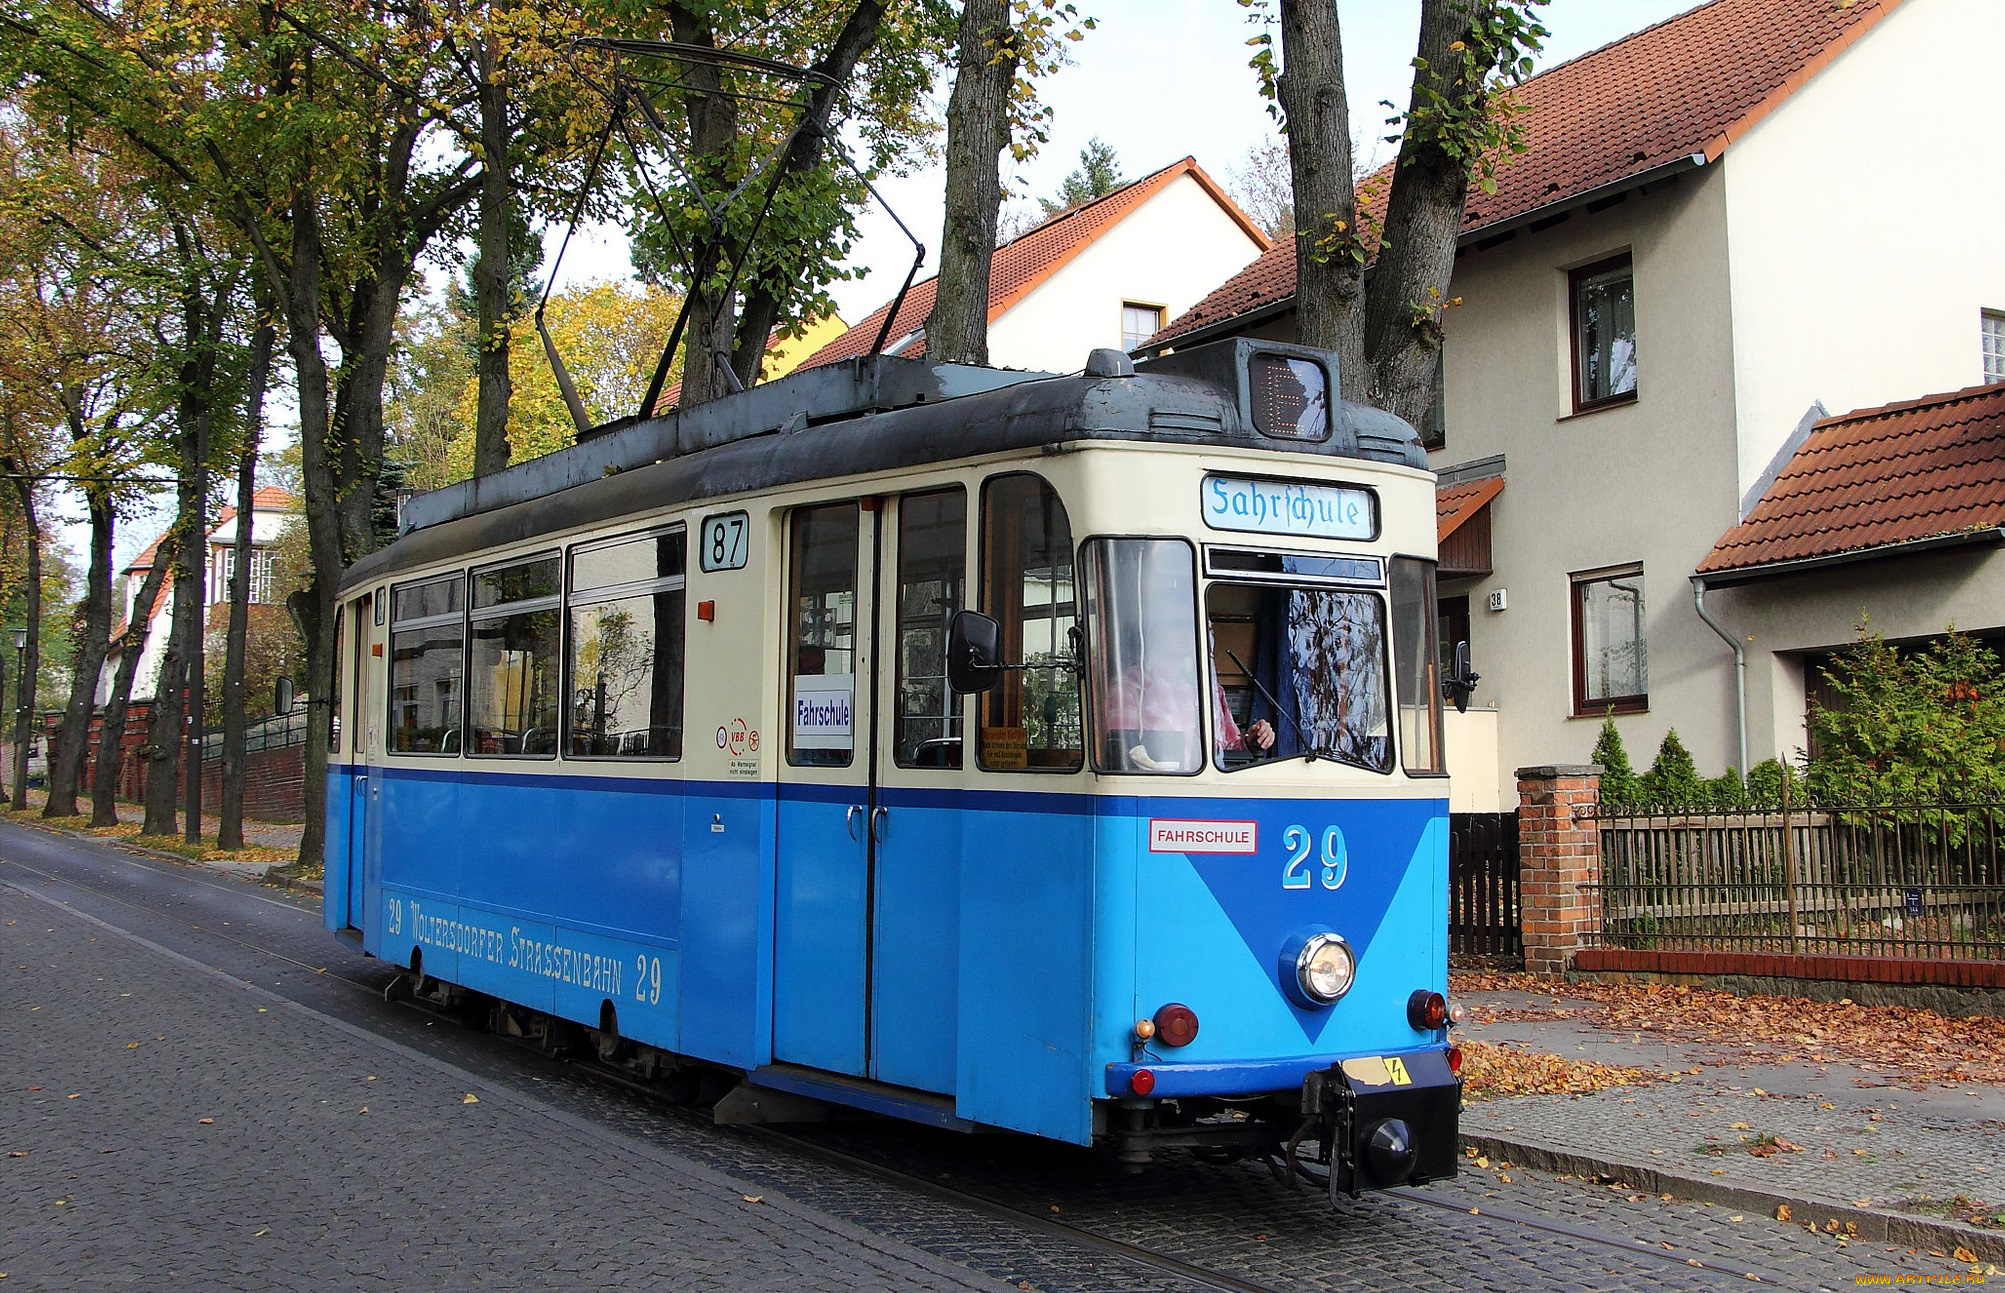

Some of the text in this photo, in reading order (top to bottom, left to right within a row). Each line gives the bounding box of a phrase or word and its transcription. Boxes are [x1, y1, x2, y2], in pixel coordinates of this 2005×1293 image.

[712, 519, 744, 565] 87
[1491, 592, 1502, 606] 38
[797, 698, 849, 726] Fahrschule
[731, 731, 745, 743] VBB
[1157, 829, 1250, 844] FAHRSCHULE
[1282, 824, 1348, 891] 29
[388, 897, 402, 935] 29
[635, 954, 662, 1006] 29
